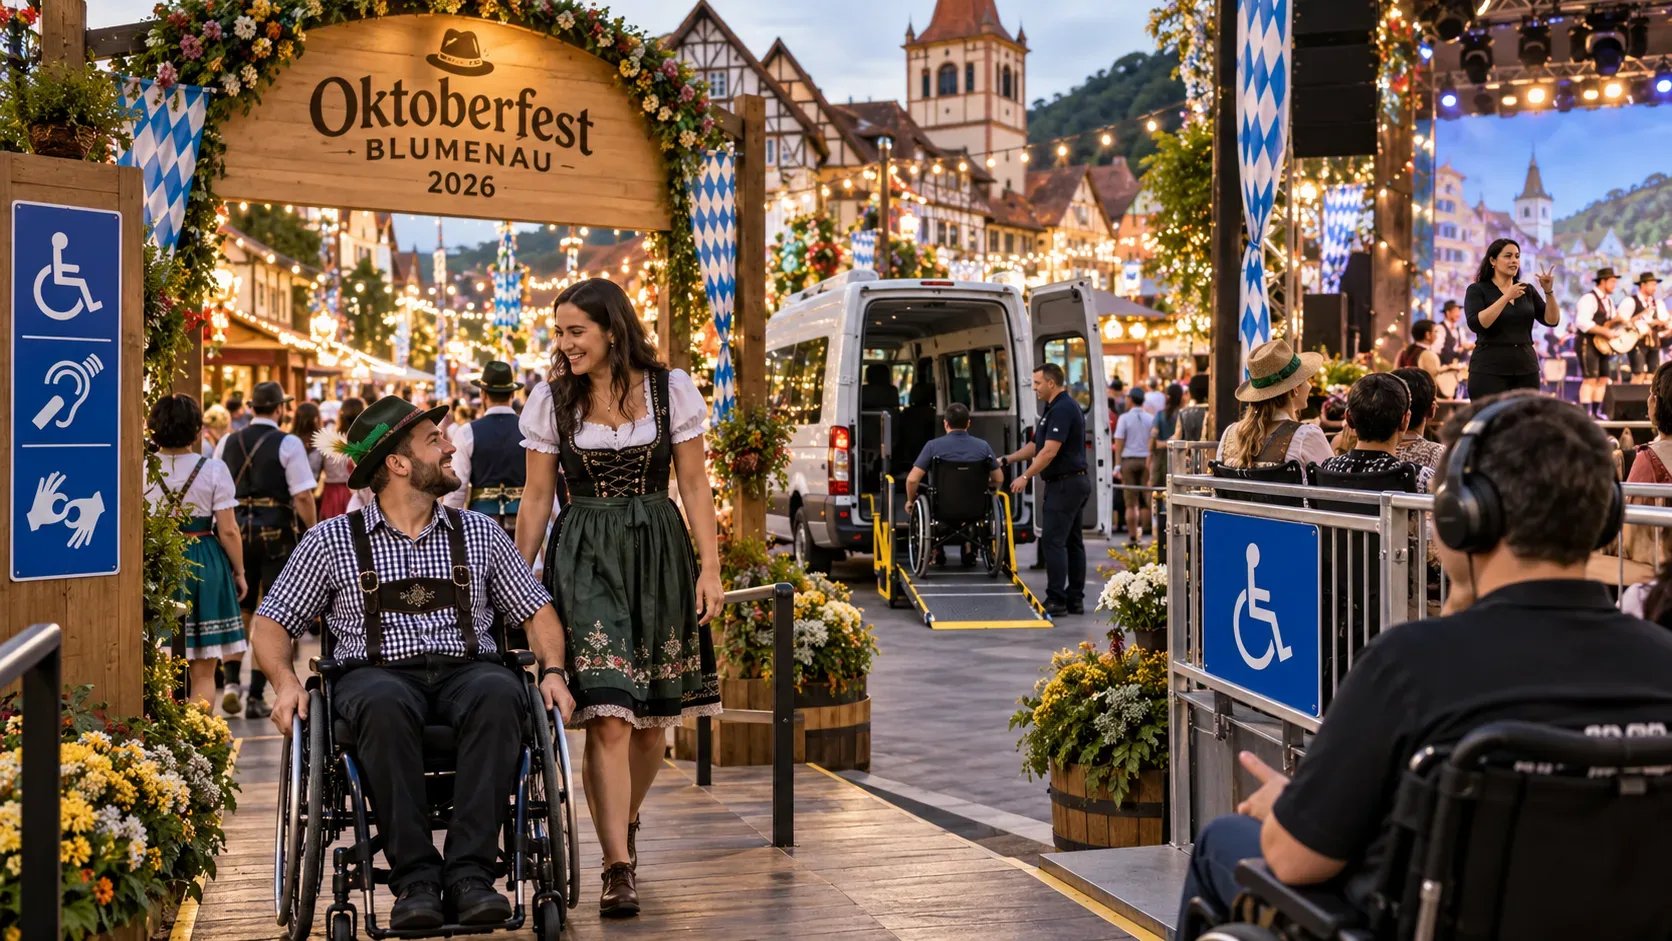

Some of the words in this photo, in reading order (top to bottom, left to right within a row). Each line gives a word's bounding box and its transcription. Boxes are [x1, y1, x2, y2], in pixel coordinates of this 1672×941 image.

[309, 75, 594, 157] Oktoberfest
[366, 137, 551, 172] BLUMENAU
[427, 170, 496, 198] 2026
